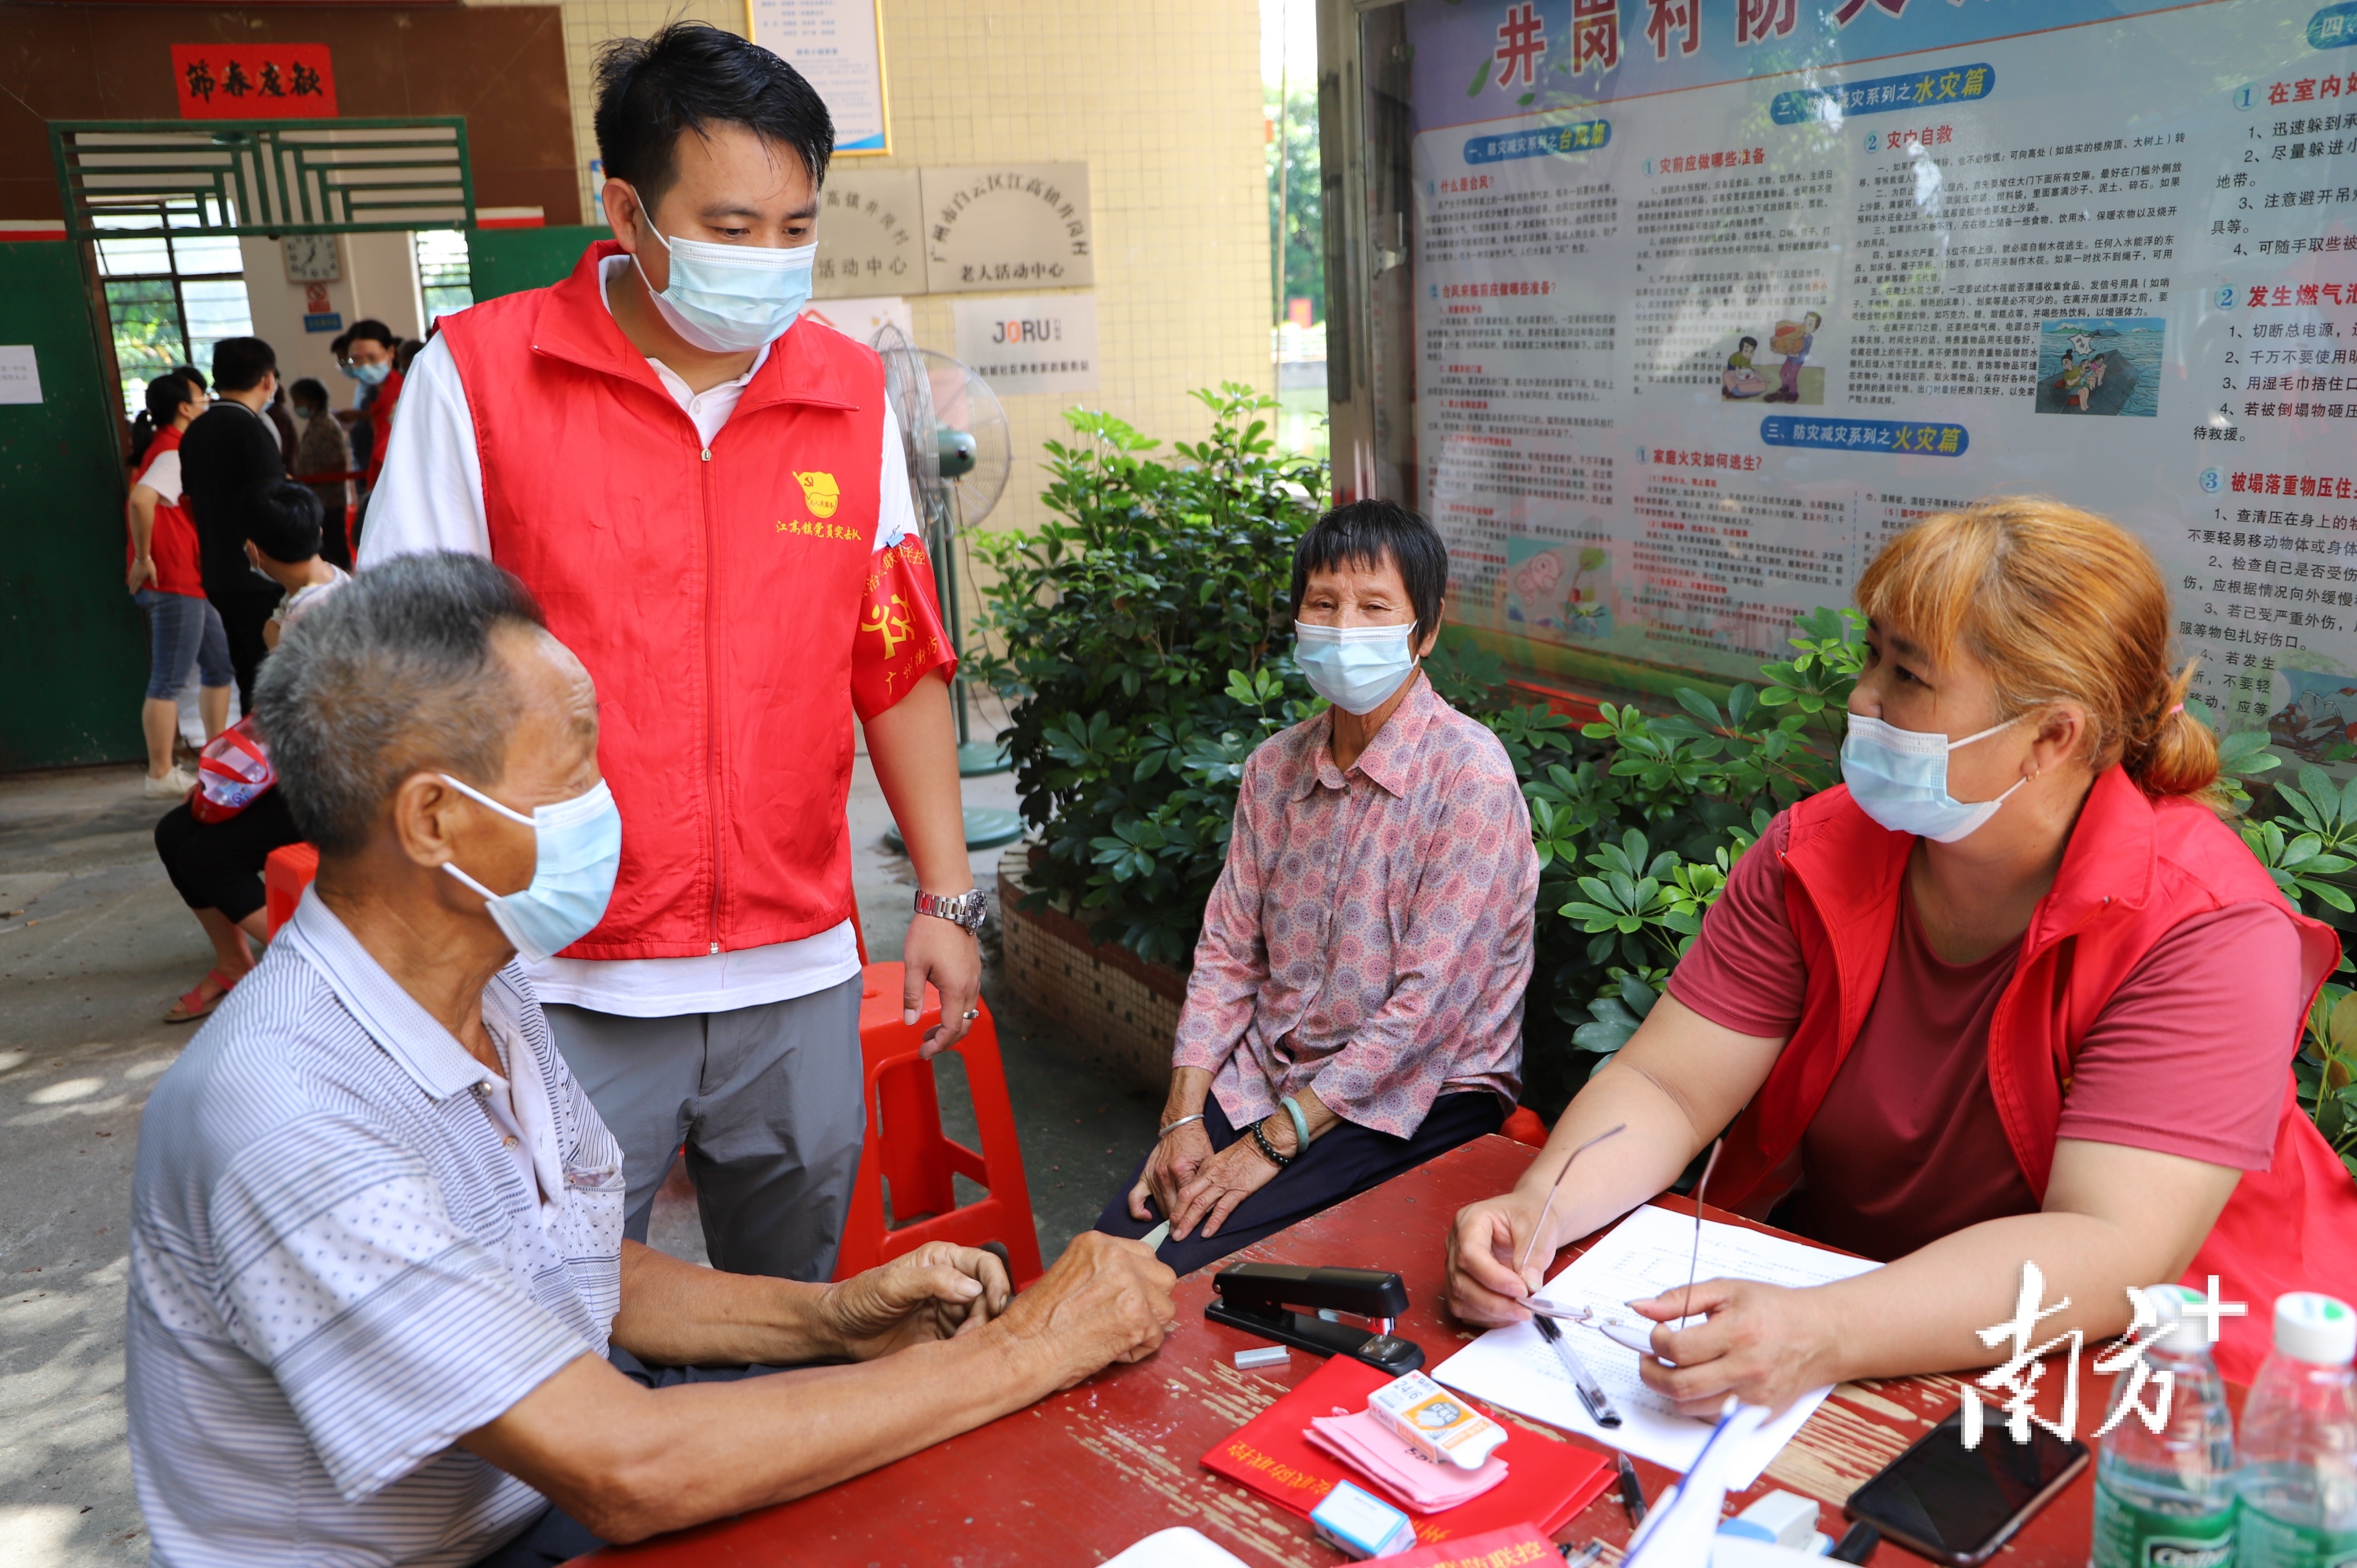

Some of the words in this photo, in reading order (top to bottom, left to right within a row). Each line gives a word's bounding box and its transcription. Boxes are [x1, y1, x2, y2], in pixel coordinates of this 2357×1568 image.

[1660, 147, 1765, 174] 灾前应做哪些准备
[929, 172, 1089, 263] 广州市白云区江高镇井岗村
[818, 255, 907, 279] 活动中心
[961, 261, 1065, 283] 老人活动中心
[993, 318, 1050, 344] JORU
[2231, 471, 2357, 500] 被塌落重物压住
[810, 500, 835, 509] 为人民服务
[776, 519, 862, 541] 江高镇党员突击队
[2183, 575, 2357, 608] 伤，应根据情况向外缓慢
[2204, 602, 2357, 632] 3、若已受严重外伤，
[886, 636, 938, 696] 广州街坊
[1393, 1380, 1423, 1400] 24/6
